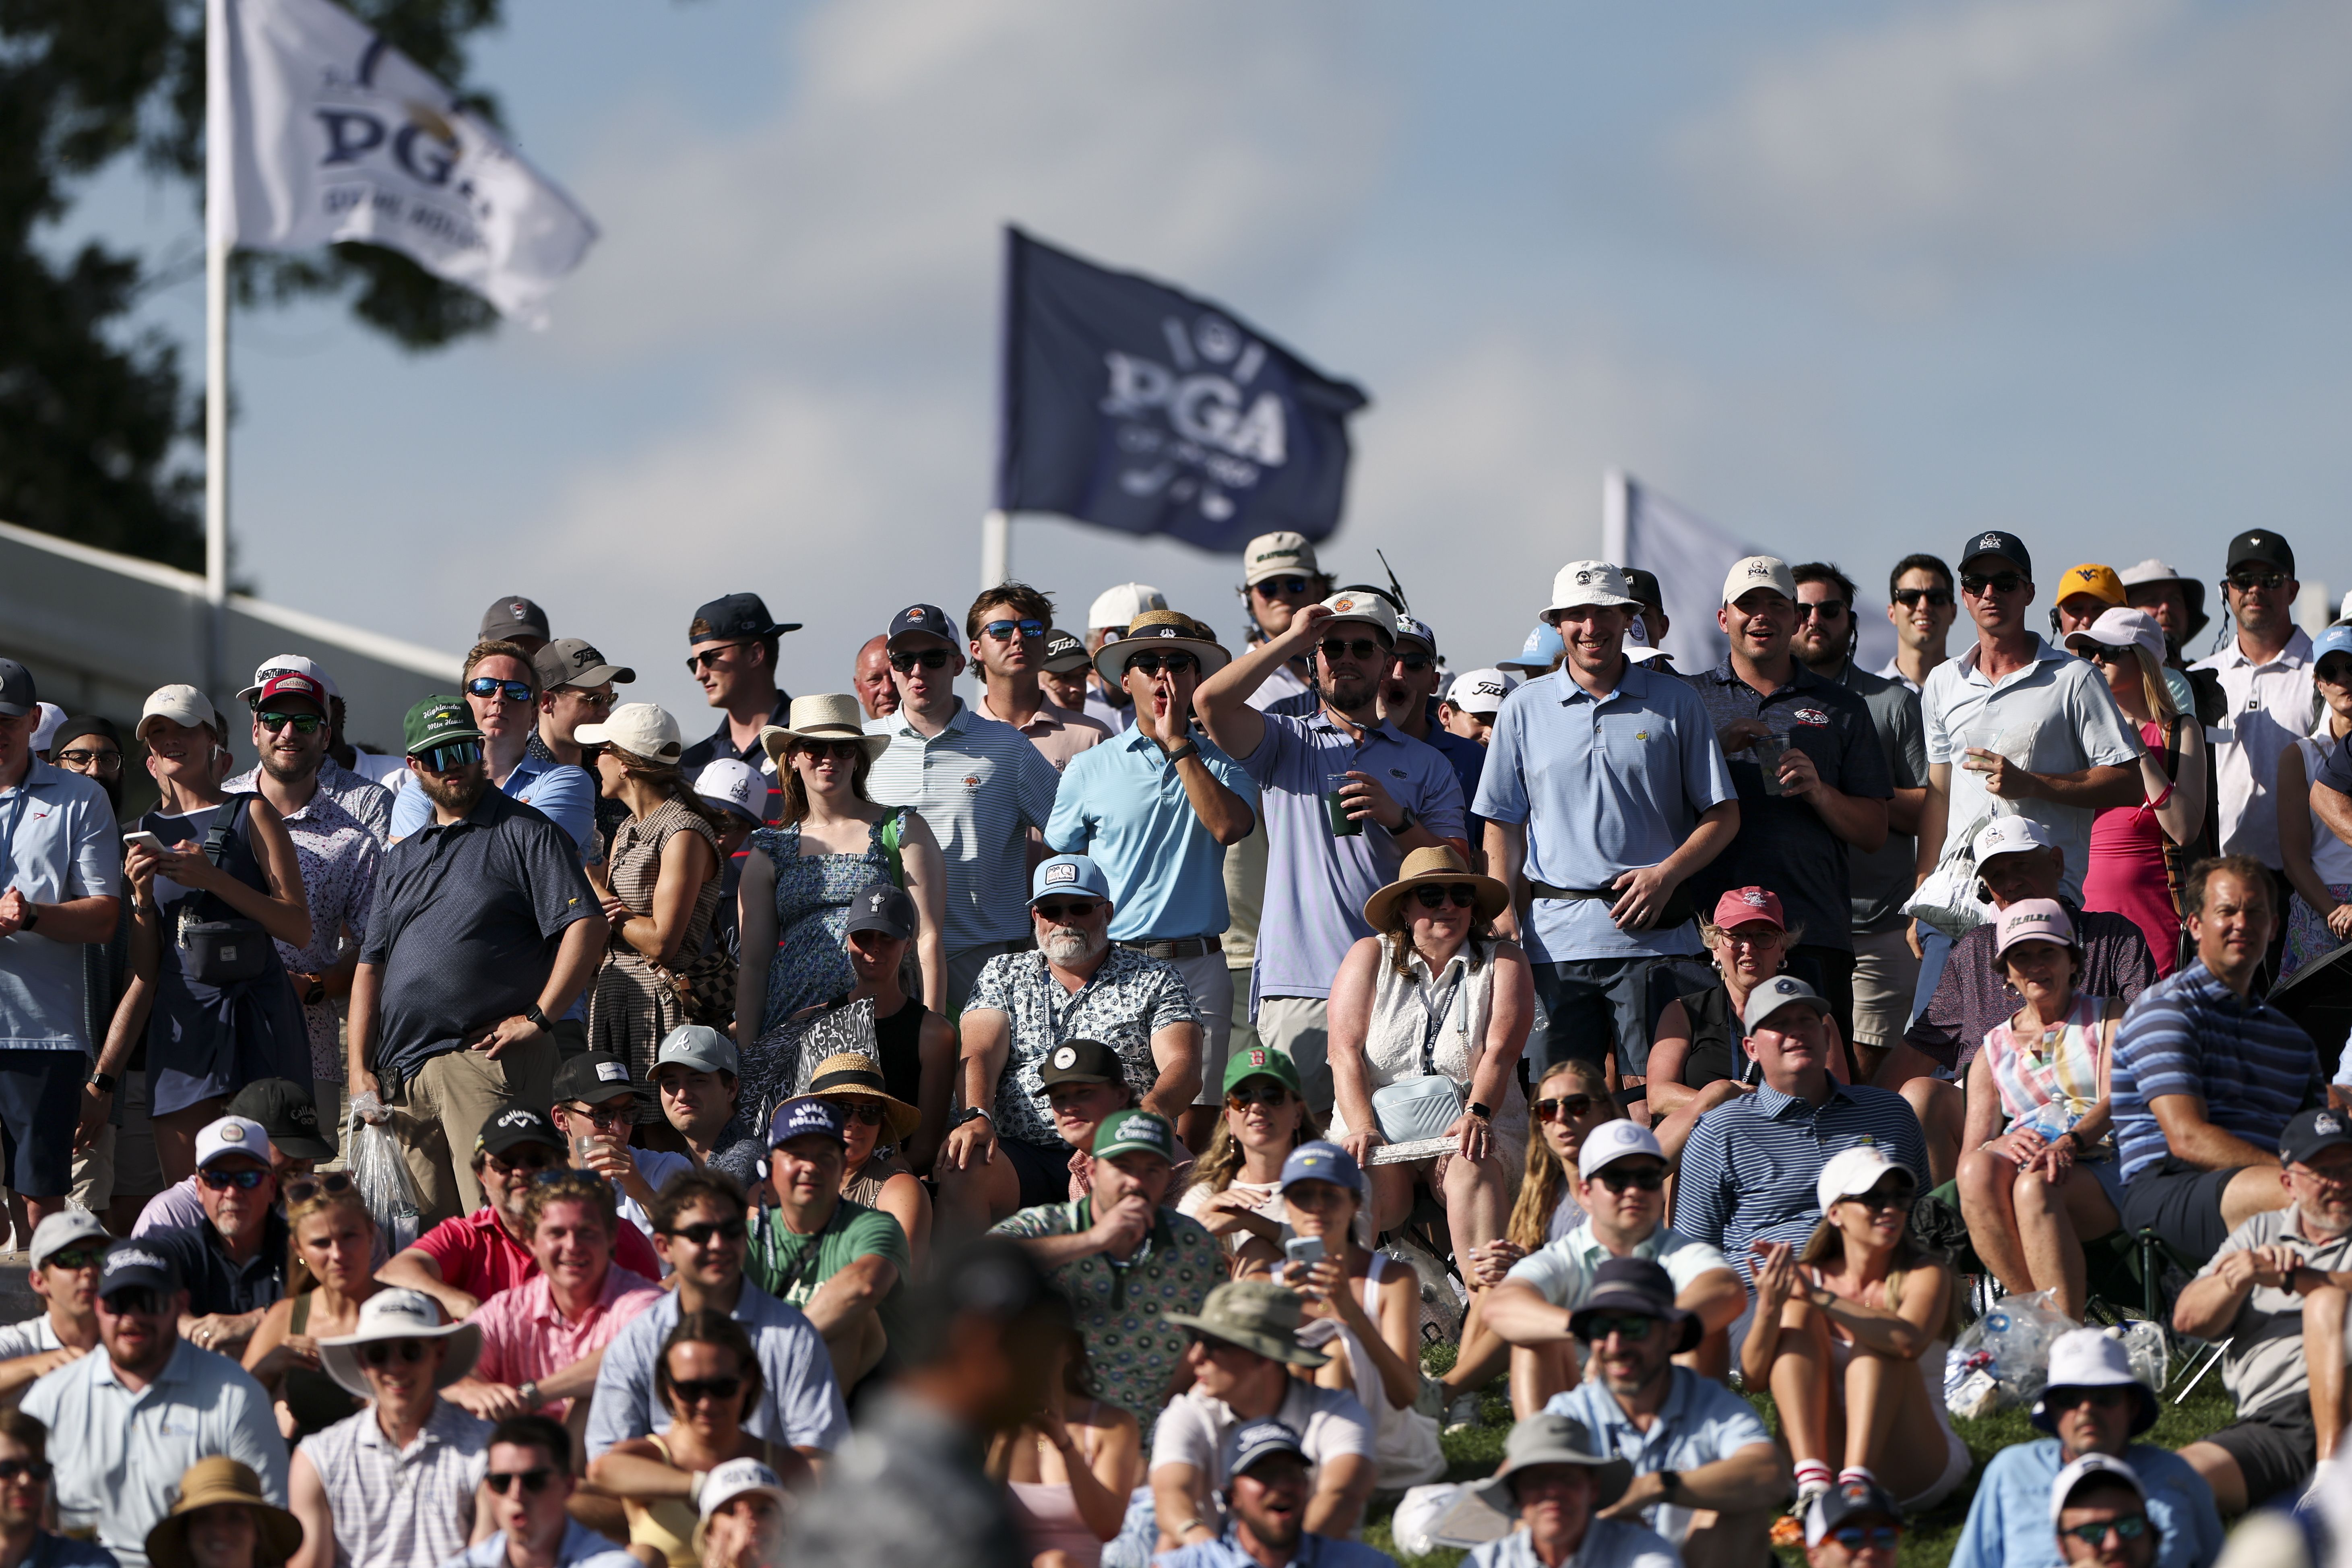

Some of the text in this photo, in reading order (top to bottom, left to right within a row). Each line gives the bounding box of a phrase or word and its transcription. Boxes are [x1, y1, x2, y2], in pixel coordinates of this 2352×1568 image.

[1100, 348, 1289, 469] PGA
[423, 704, 461, 719] Highlander
[1985, 833, 2004, 845] PGA
[2006, 914, 2051, 934] AZALEA
[1057, 1011, 1073, 1036] CHAMPIONSHIP
[1073, 993, 1086, 1009] CHASE
[1437, 1000, 1450, 1024] CHAMPIONSHIP
[669, 1031, 690, 1052] A
[1429, 1028, 1440, 1044] CHASE
[1249, 1049, 1265, 1068] B
[795, 1103, 828, 1118] QUAIL
